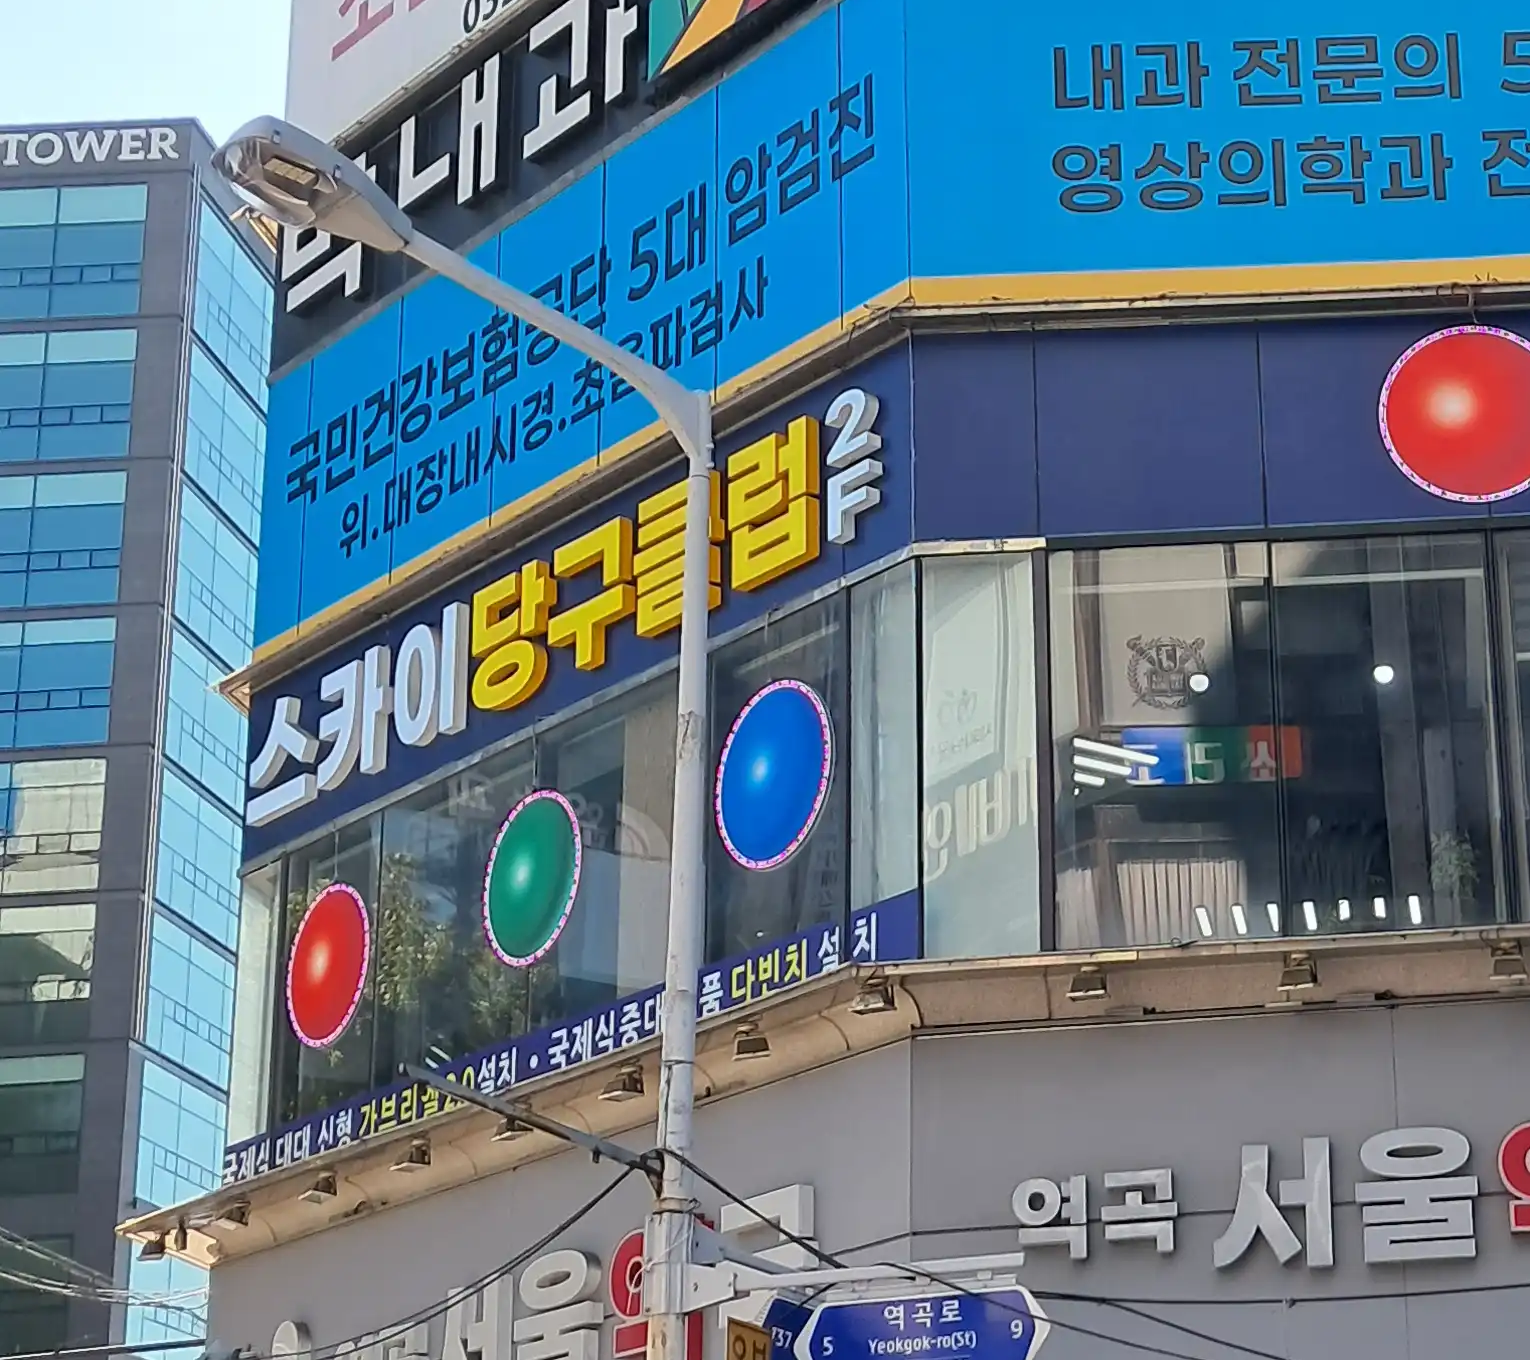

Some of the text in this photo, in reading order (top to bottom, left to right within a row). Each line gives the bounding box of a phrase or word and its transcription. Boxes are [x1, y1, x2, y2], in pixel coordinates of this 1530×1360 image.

[1051, 40, 1209, 113] 내과
[1231, 32, 1462, 109] 전문의
[0, 127, 180, 167] TOWER
[1051, 132, 1451, 214] 영상의학과
[626, 181, 708, 304] 5대
[724, 73, 877, 248] 암검진
[730, 937, 809, 1003] 다빈치
[816, 911, 879, 974] 설치
[1009, 1167, 1178, 1260] 역곡
[822, 1318, 1024, 1357] 5 Yeokgok-ro(St) 9
[883, 1298, 963, 1332] 역곡로
